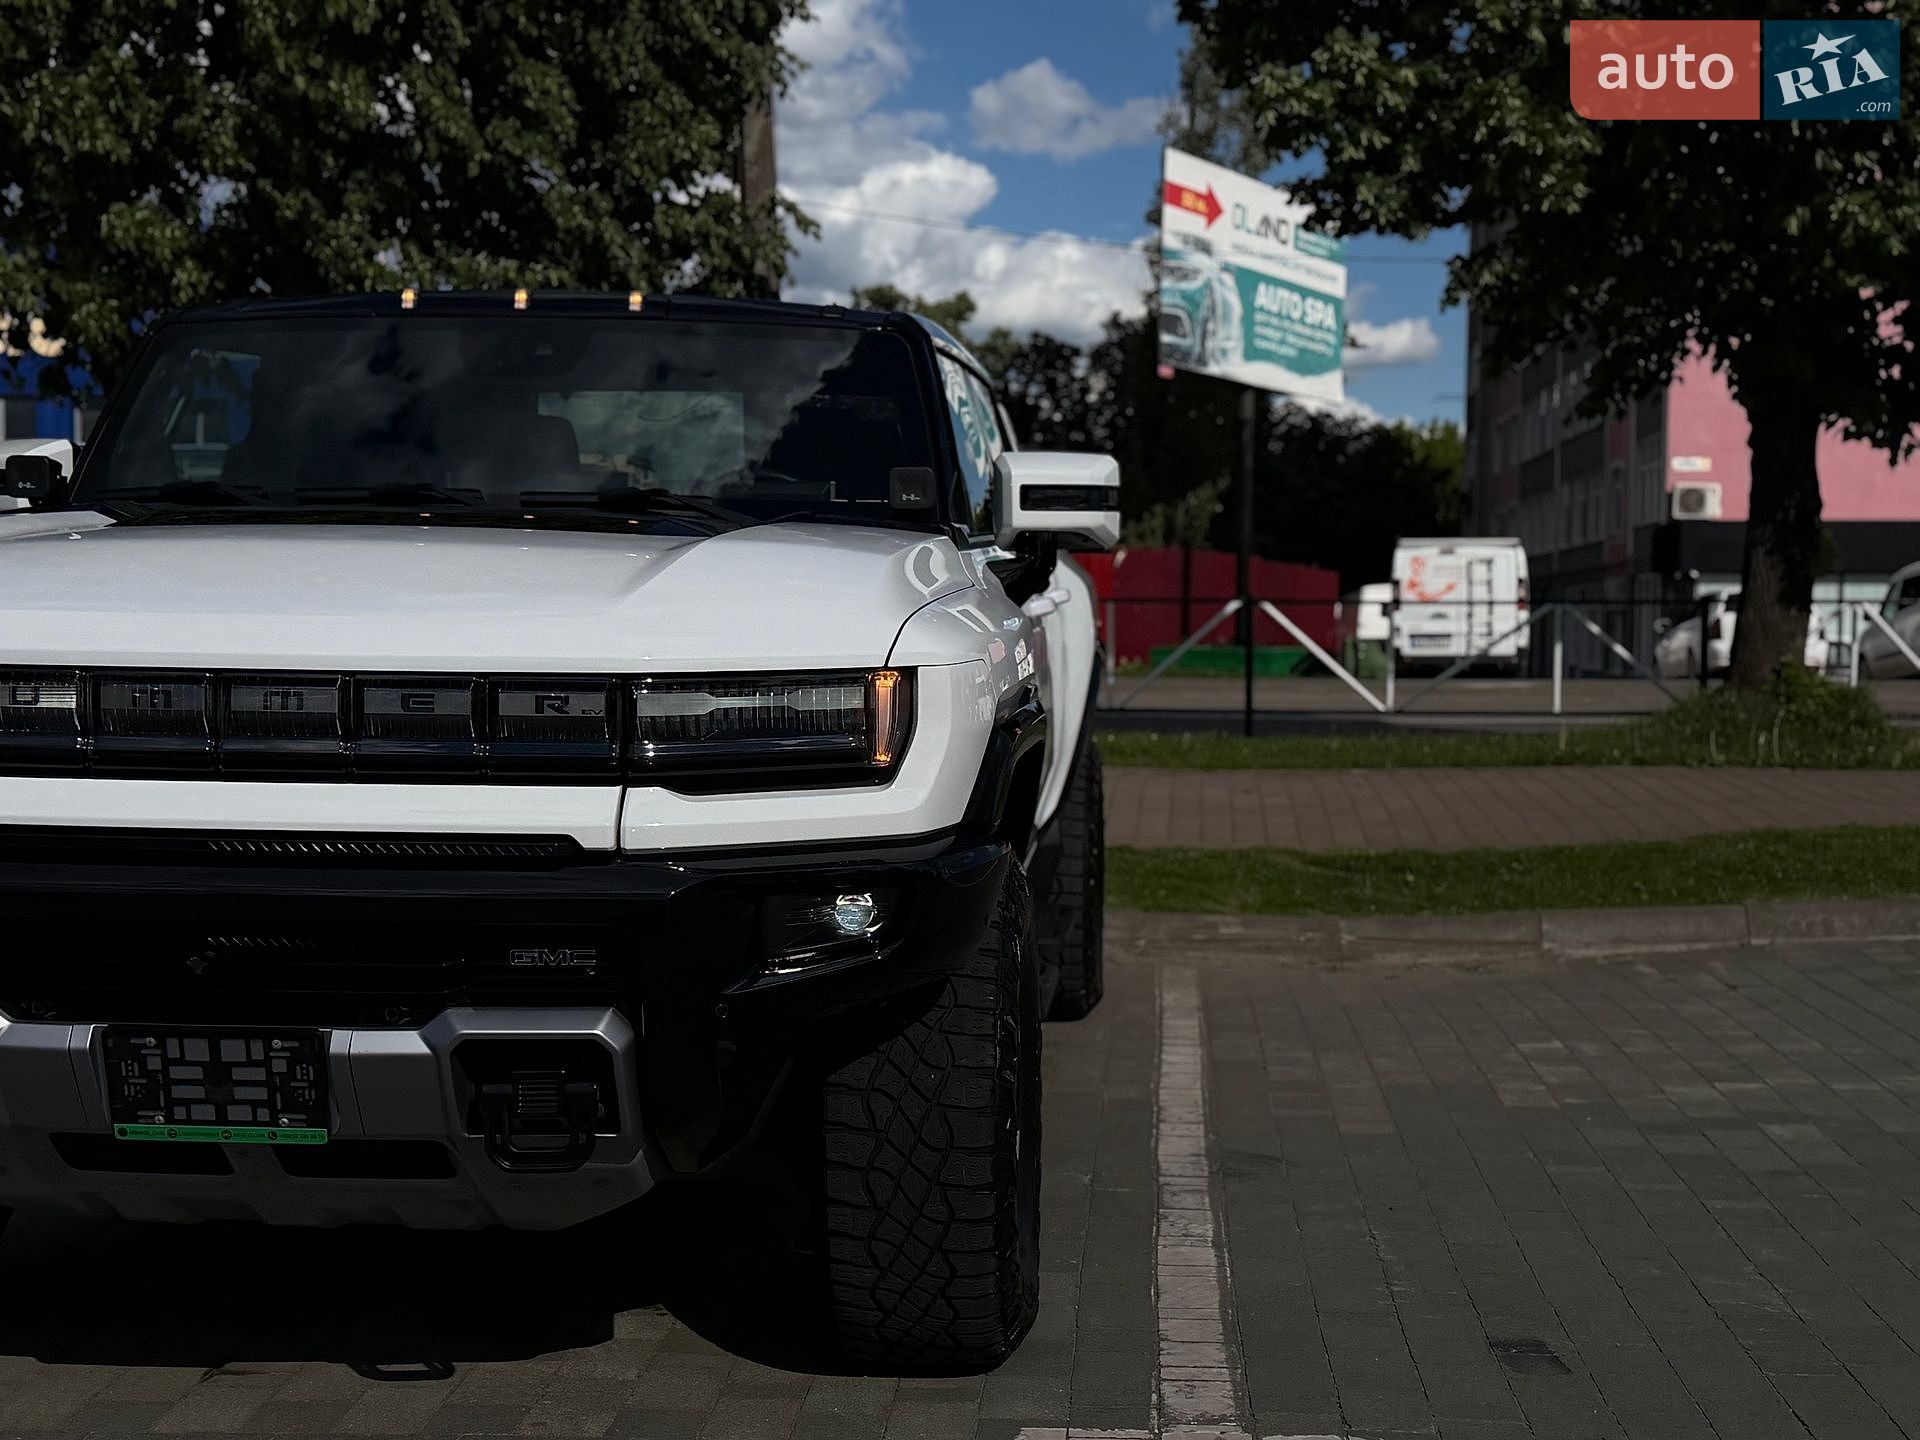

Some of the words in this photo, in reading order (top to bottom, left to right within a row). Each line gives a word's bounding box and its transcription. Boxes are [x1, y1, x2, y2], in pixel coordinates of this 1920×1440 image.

[1254, 282, 1304, 321] AUTO
[1304, 296, 1337, 331] SPA
[510, 949, 596, 965] GMC
